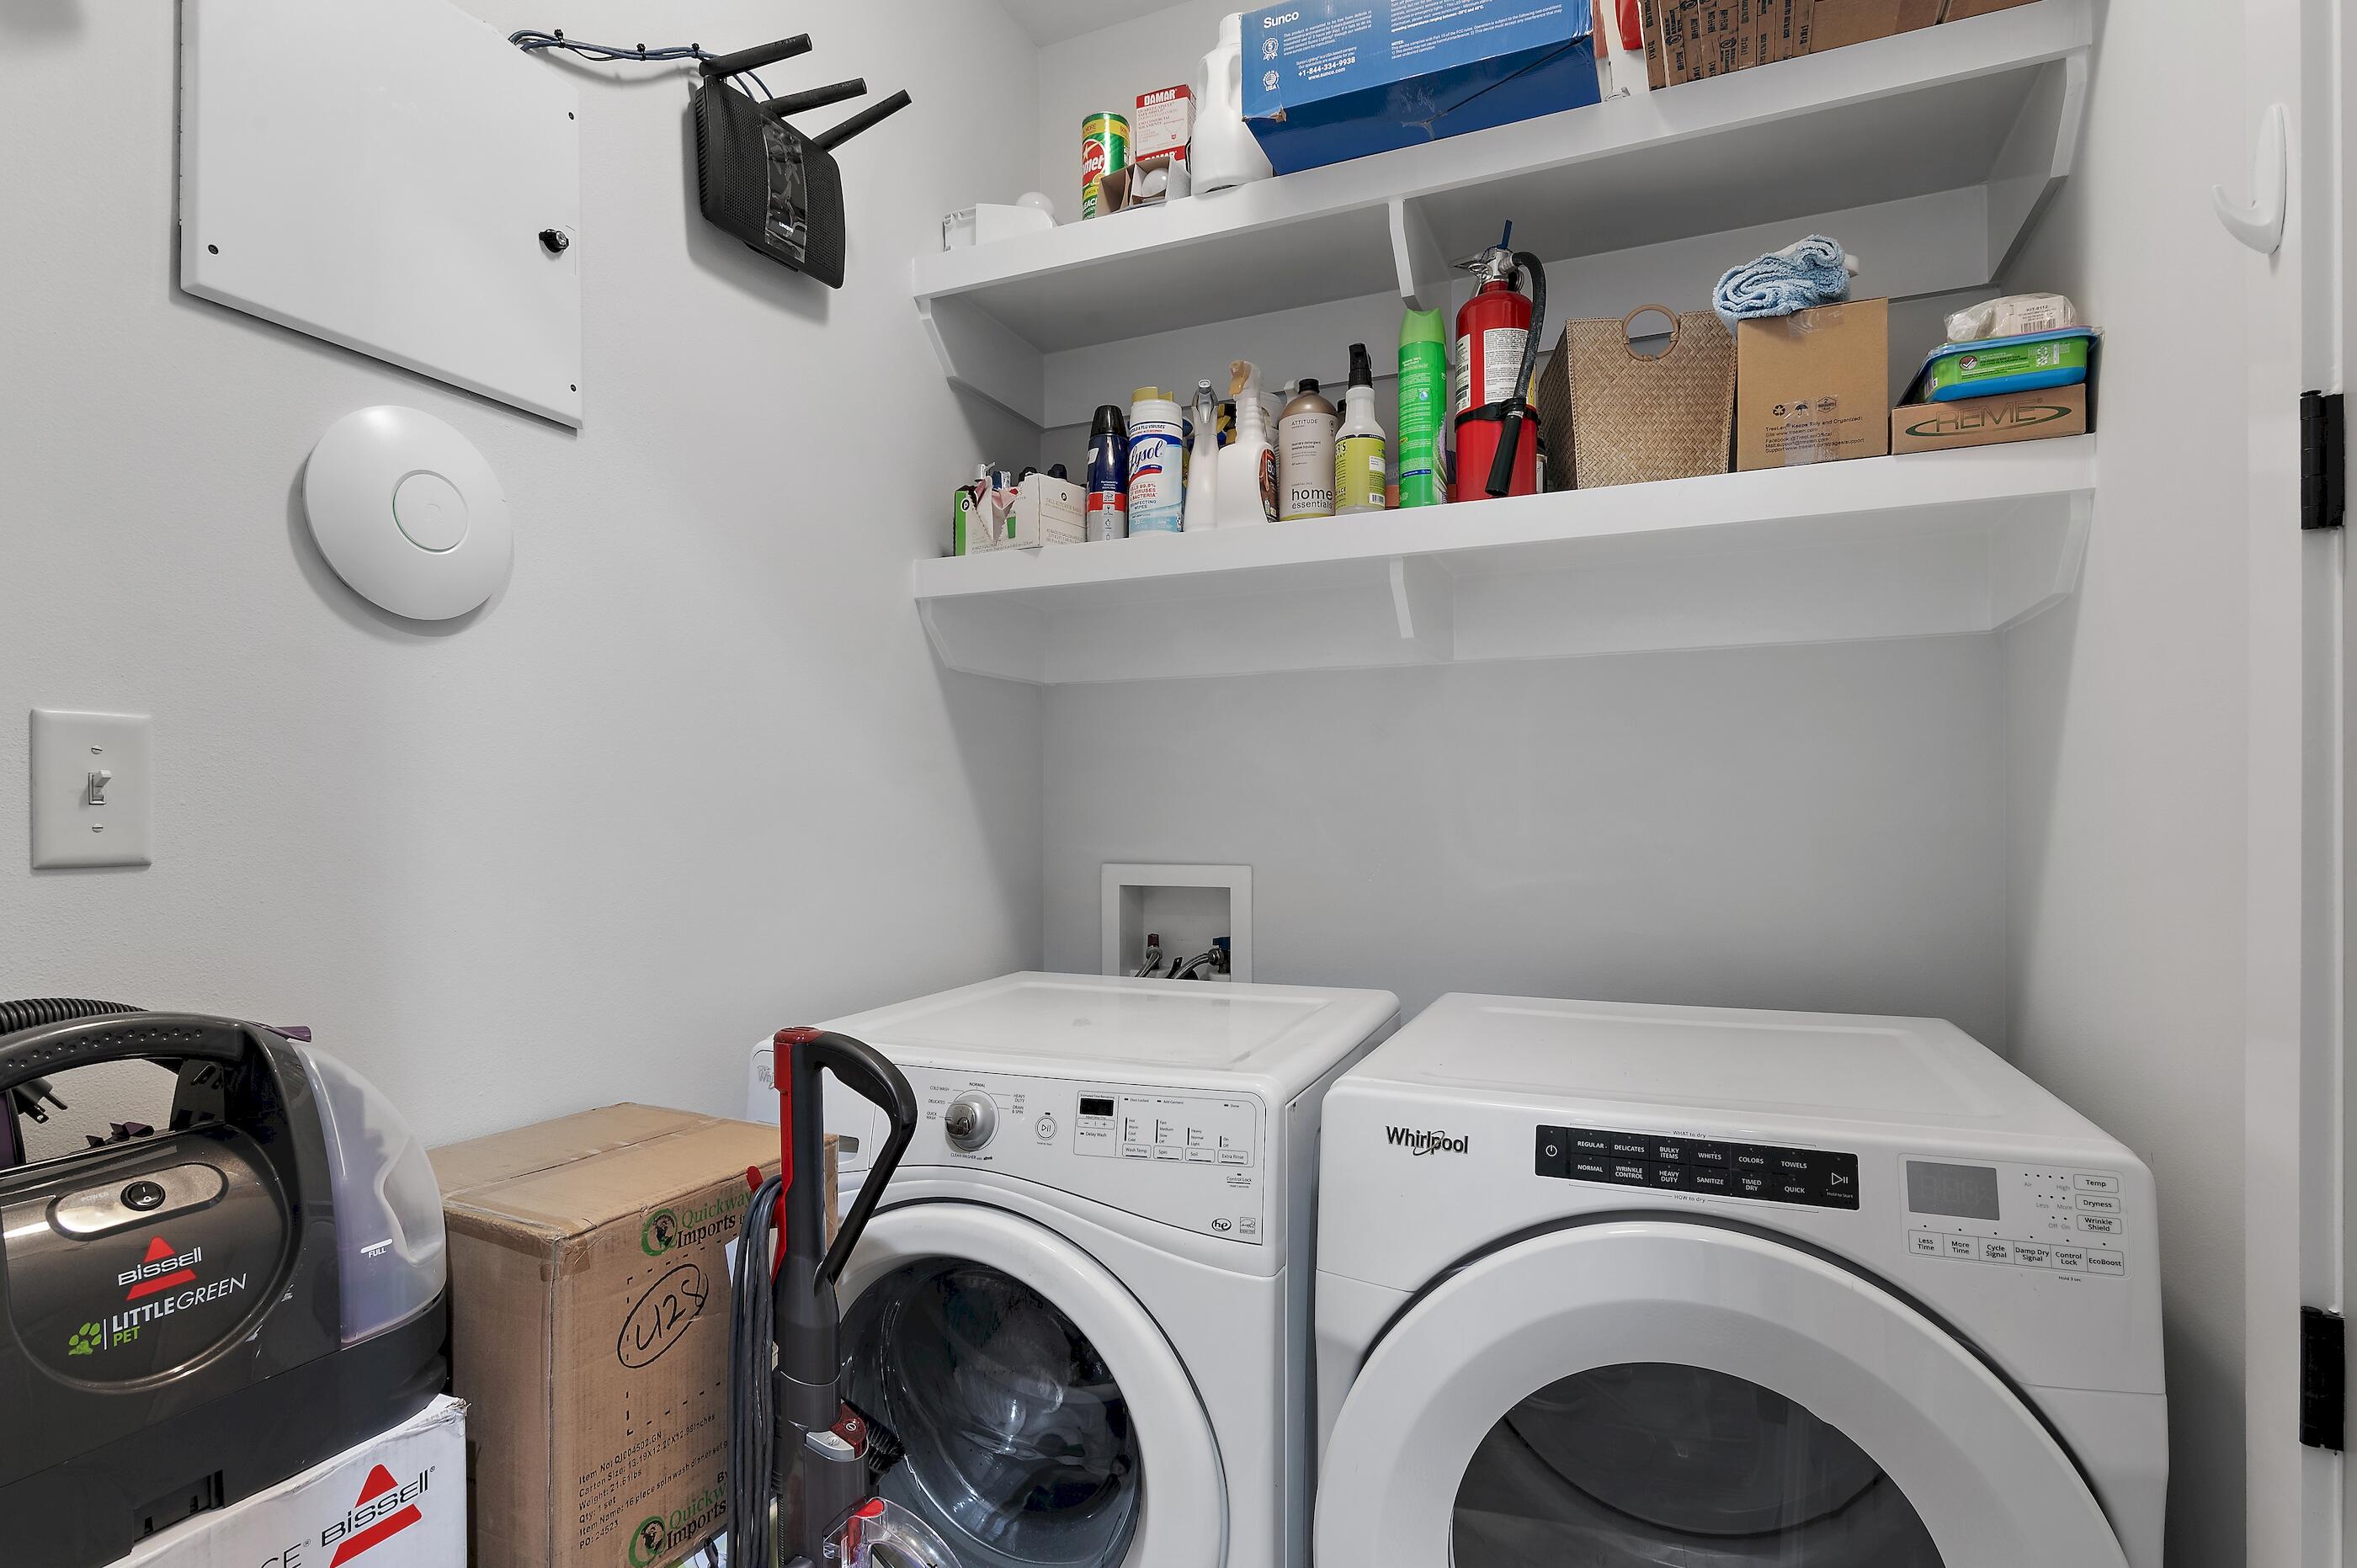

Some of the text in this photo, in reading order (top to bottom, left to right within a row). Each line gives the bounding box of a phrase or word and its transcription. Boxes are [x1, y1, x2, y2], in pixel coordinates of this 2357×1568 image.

[1264, 11, 1300, 29] Sunco
[1298, 57, 1356, 77] +1-844-334-9938
[1308, 67, 1346, 80] www.sunco.com
[1130, 439, 1163, 473] Lysol
[1292, 488, 1333, 501] home
[1292, 500, 1332, 509] essentials
[1386, 1125, 1468, 1155] Whirlpool
[1614, 1144, 1644, 1153] DELICATES
[1739, 1156, 1764, 1164] COLORS
[1781, 1161, 1807, 1169] TOWELS
[80, 1192, 109, 1202] POWER
[2083, 1200, 2112, 1208] Dryness
[682, 1192, 752, 1229] Quickway
[1214, 1219, 1228, 1230] he
[2085, 1217, 2113, 1225] Wrinkle
[677, 1214, 736, 1249] Imports
[368, 1247, 386, 1258] FULL
[1986, 1250, 2007, 1258] Signal
[2089, 1258, 2121, 1266] EcoBoost
[114, 1326, 140, 1347] PET
[579, 1469, 597, 1484] Item
[600, 1462, 613, 1472] No:
[579, 1478, 605, 1497] Carton
[608, 1468, 625, 1482] Size:
[579, 1489, 608, 1511] Weight:
[579, 1522, 597, 1537] Item
[600, 1506, 624, 1523] Name:
[625, 1497, 634, 1508] 16
[636, 1486, 655, 1504] piece
[657, 1477, 672, 1490] spin
[673, 1463, 690, 1479] wash
[579, 1496, 616, 1523] Qty: 1 set
[665, 1499, 726, 1551] Imports
[579, 1520, 619, 1549] PO: 24523
